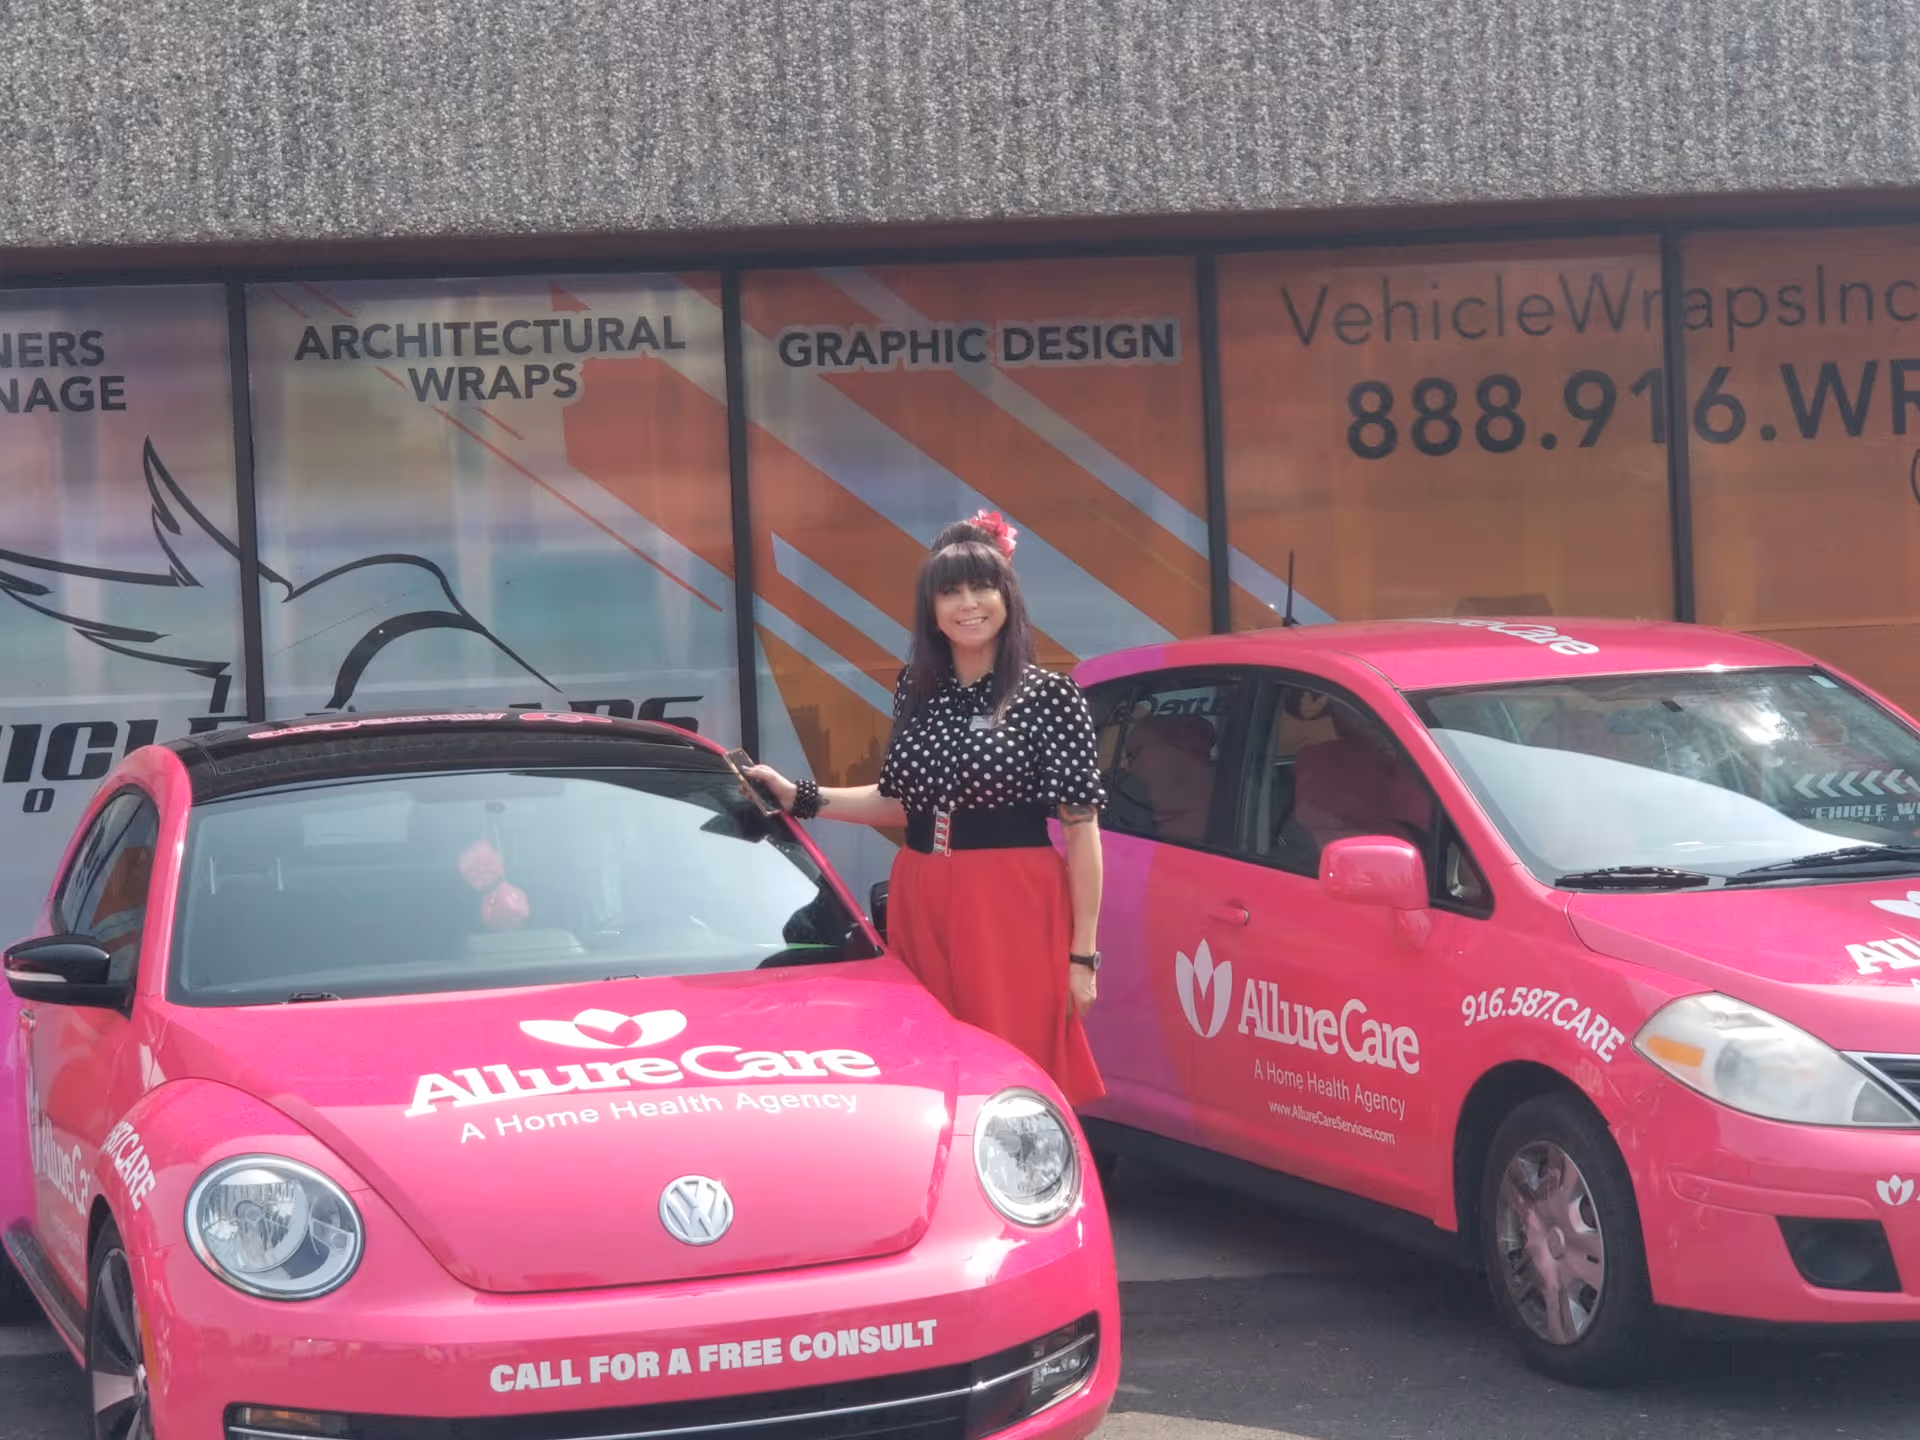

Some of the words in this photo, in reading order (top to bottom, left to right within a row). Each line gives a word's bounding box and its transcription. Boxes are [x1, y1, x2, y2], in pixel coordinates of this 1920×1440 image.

[295, 315, 686, 360] ARCHITECTURAL
[779, 328, 986, 367] GRAPHIC
[1003, 323, 1175, 362] DESIGN
[0, 375, 126, 413] NAGE
[408, 362, 578, 402] WRAPS
[1238, 978, 1419, 1074] AllureCare
[1462, 987, 1625, 1064] 916.587.CARE
[404, 1045, 881, 1117] AllureCare
[1253, 1058, 1264, 1081] A
[1266, 1061, 1304, 1090] Home
[1307, 1071, 1350, 1102] Health
[1354, 1083, 1406, 1121] Agency
[460, 1122, 486, 1144] A
[494, 1107, 600, 1136] Home
[610, 1093, 723, 1120] Health
[735, 1091, 857, 1114] Agency
[1268, 1100, 1396, 1145] www.AllureCareServices.com
[489, 1359, 582, 1393] CALL
[589, 1350, 660, 1384] FOR
[667, 1347, 693, 1376] A
[699, 1337, 783, 1372] FREE
[789, 1319, 938, 1362] CONSULT
